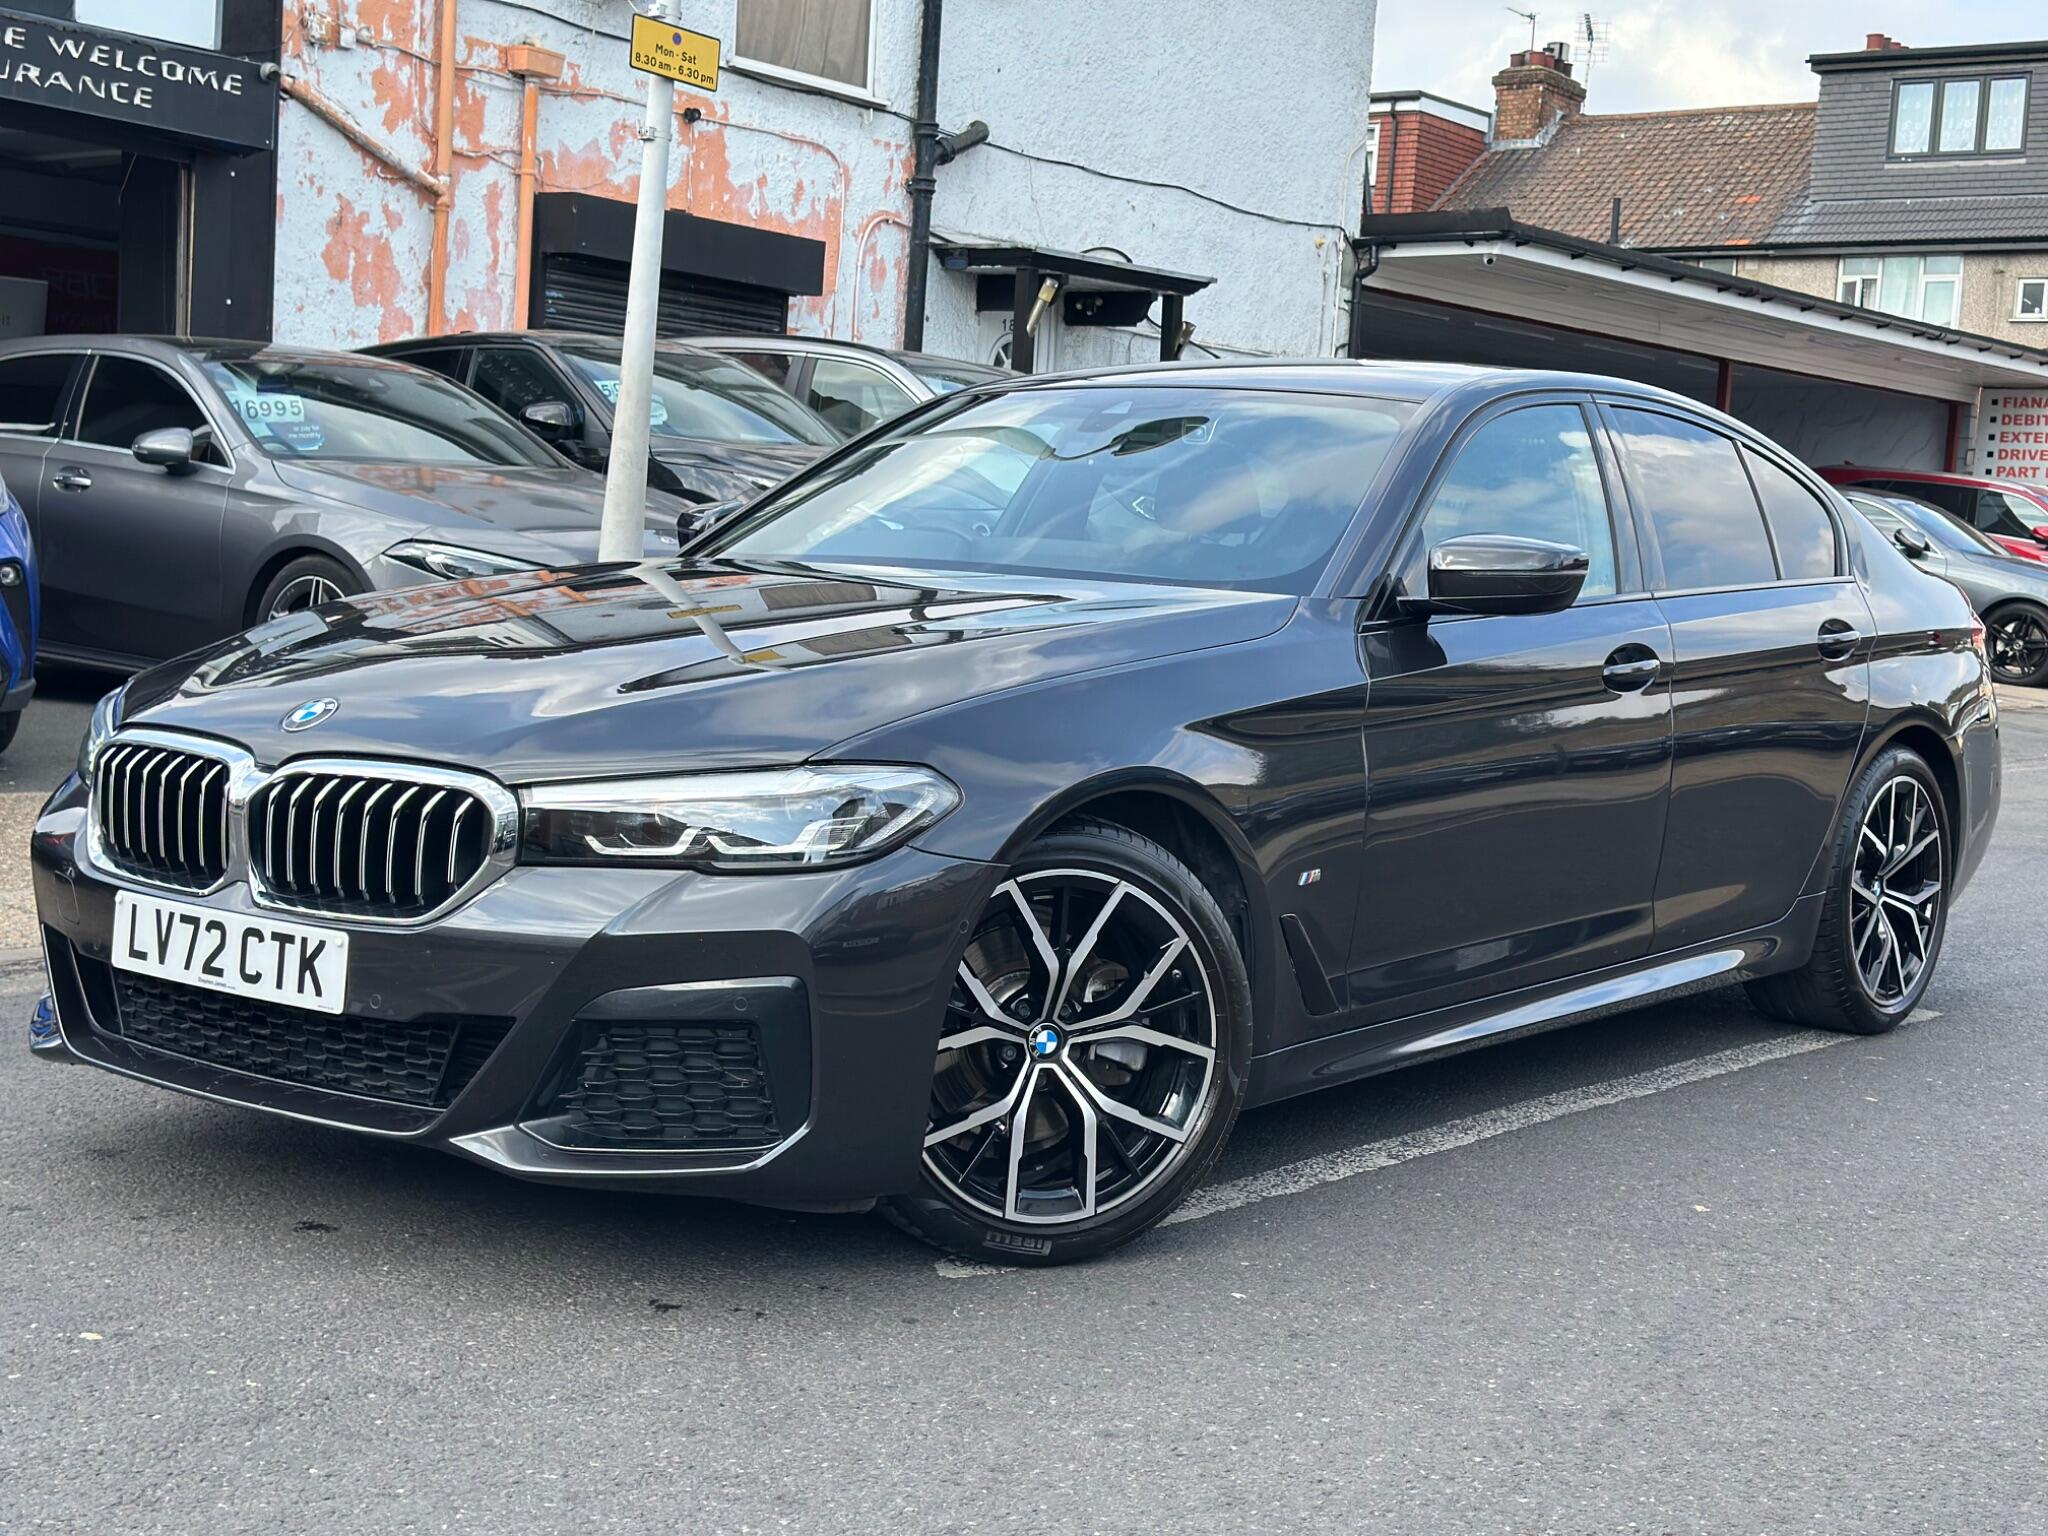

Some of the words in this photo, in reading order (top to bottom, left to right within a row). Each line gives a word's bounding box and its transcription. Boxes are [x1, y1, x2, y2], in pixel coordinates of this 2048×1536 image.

[47, 34, 243, 96] WELCOME
[635, 52, 657, 67] 8.30
[678, 65, 700, 80] 6.30
[700, 74, 714, 84] pm
[655, 43, 674, 58] Mon
[681, 51, 697, 65] Sat
[1996, 466, 2040, 478] PART
[128, 903, 228, 978] LV72
[239, 926, 327, 998] CTK
